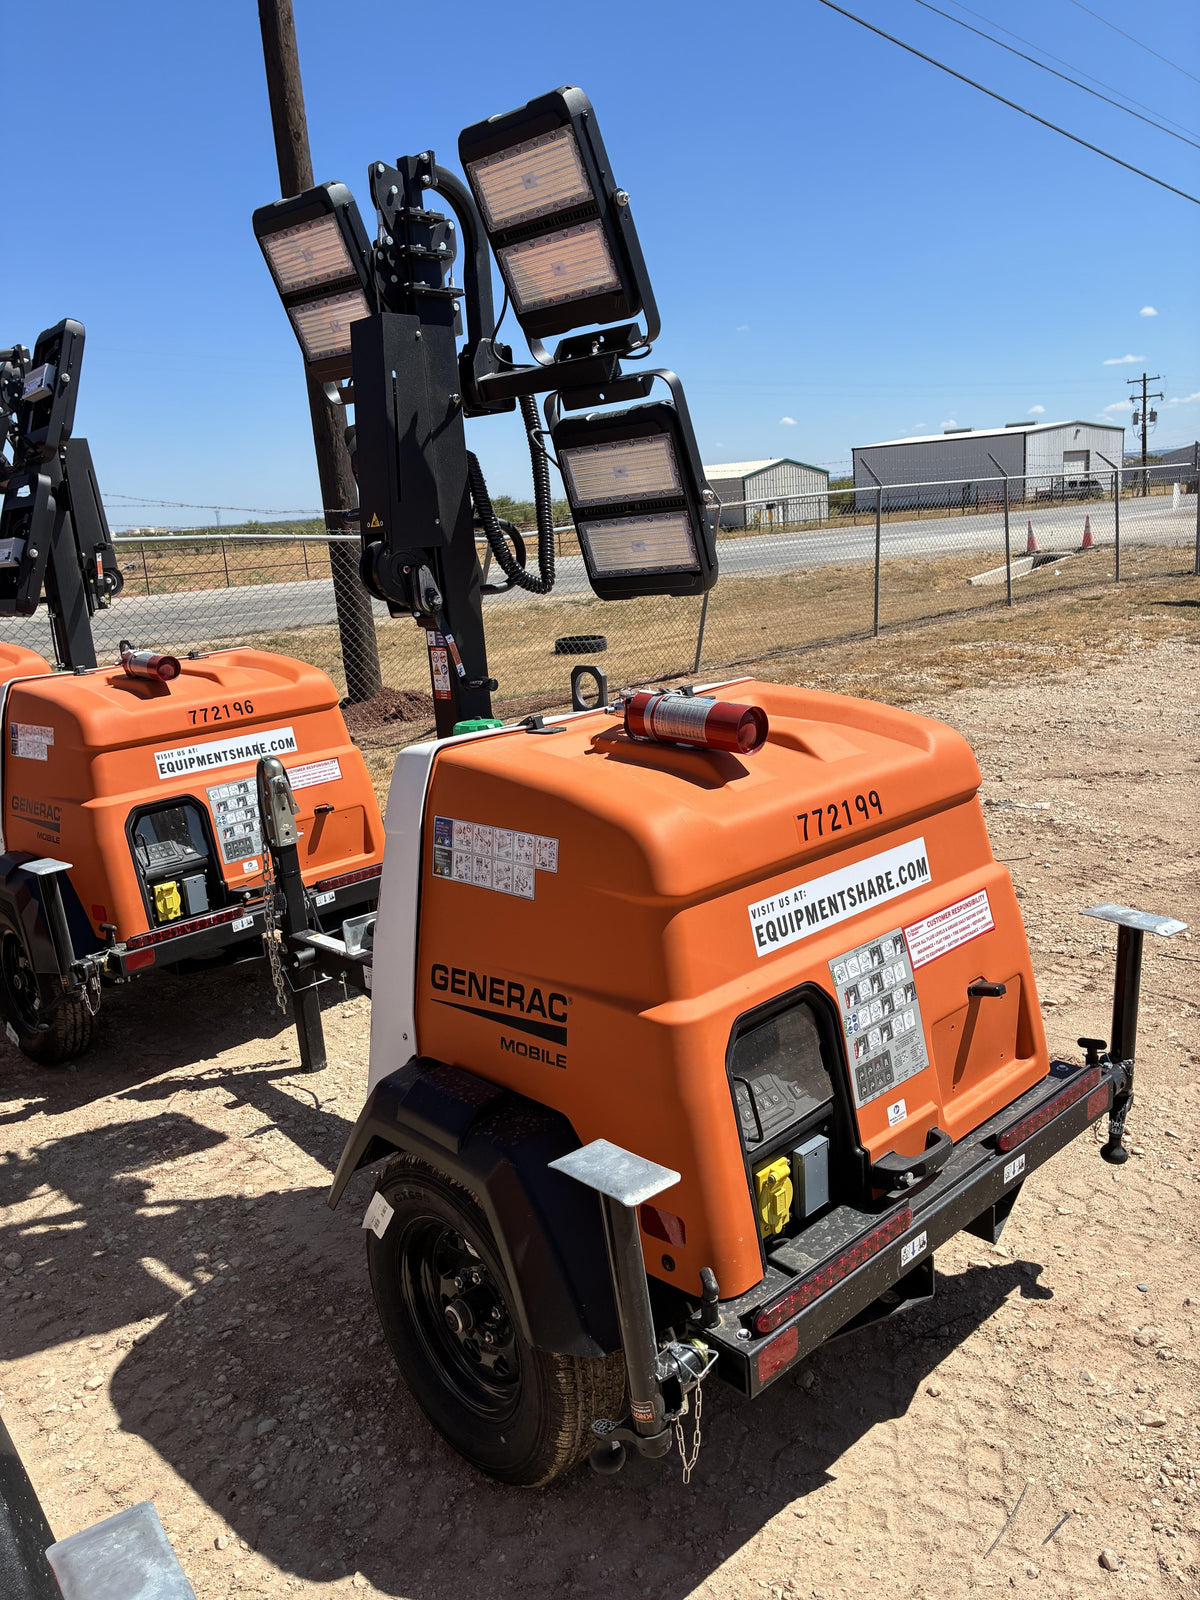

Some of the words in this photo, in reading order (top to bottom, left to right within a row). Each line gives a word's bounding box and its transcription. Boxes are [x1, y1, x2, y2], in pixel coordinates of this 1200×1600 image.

[188, 700, 254, 725] 772196
[156, 752, 174, 761] VISIT
[177, 749, 186, 757] US
[158, 737, 295, 775] EQUIPMENTSHARE.COM
[11, 796, 60, 822] GENERAC
[797, 790, 883, 841] 772199
[36, 831, 60, 844] MOBILE
[751, 901, 775, 920] VISIT
[778, 895, 790, 909] US
[793, 890, 807, 903] AT:
[755, 856, 928, 948] EQUIPMENTSHARE.COM
[926, 910, 951, 927] CUSTOMER
[951, 894, 984, 915] RESPONSIBILITY
[431, 963, 568, 1023] GENERAC
[500, 1036, 567, 1069] MOBILE
